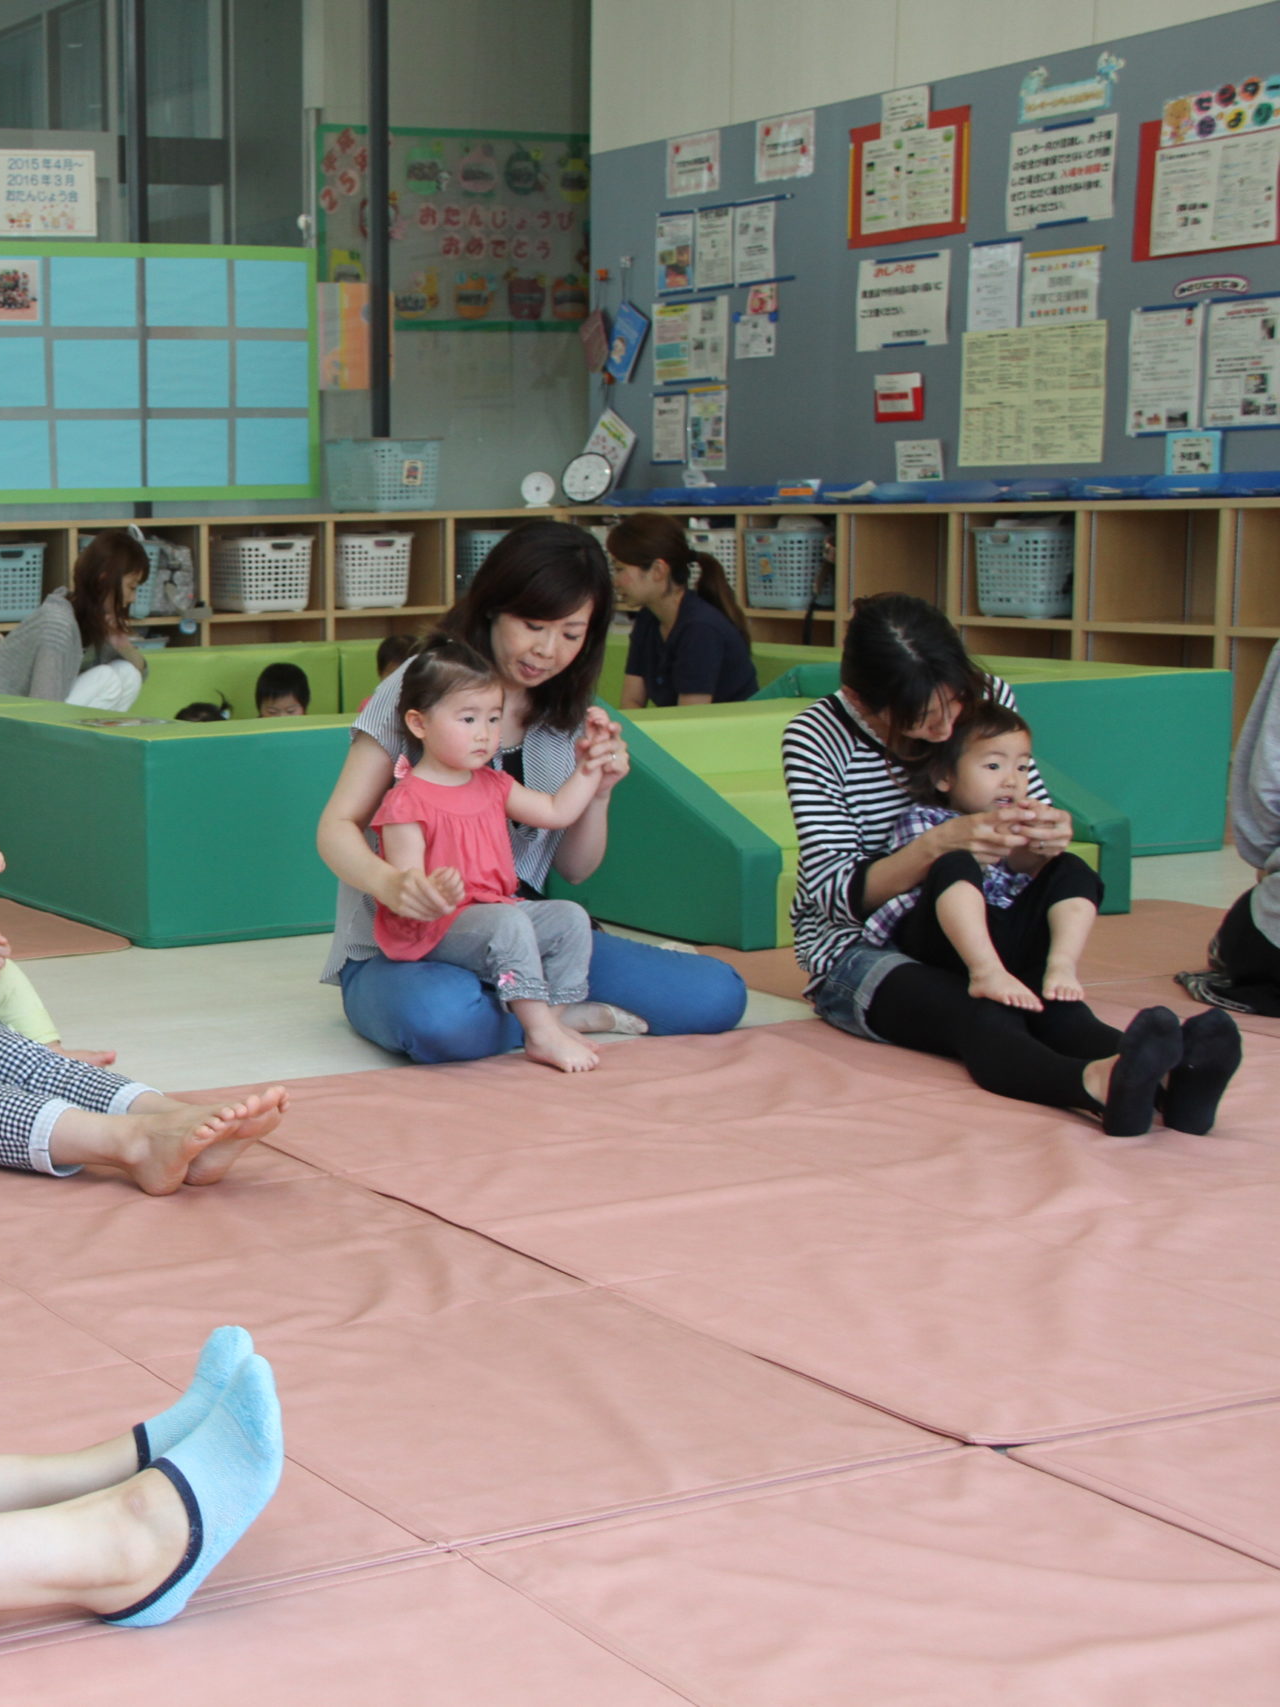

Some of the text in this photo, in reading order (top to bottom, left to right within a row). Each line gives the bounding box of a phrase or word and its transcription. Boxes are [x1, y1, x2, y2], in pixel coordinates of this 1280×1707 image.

[419, 204, 577, 233] おたんじょうび
[441, 236, 554, 261] おめでとう
[873, 263, 917, 279] おしらせ
